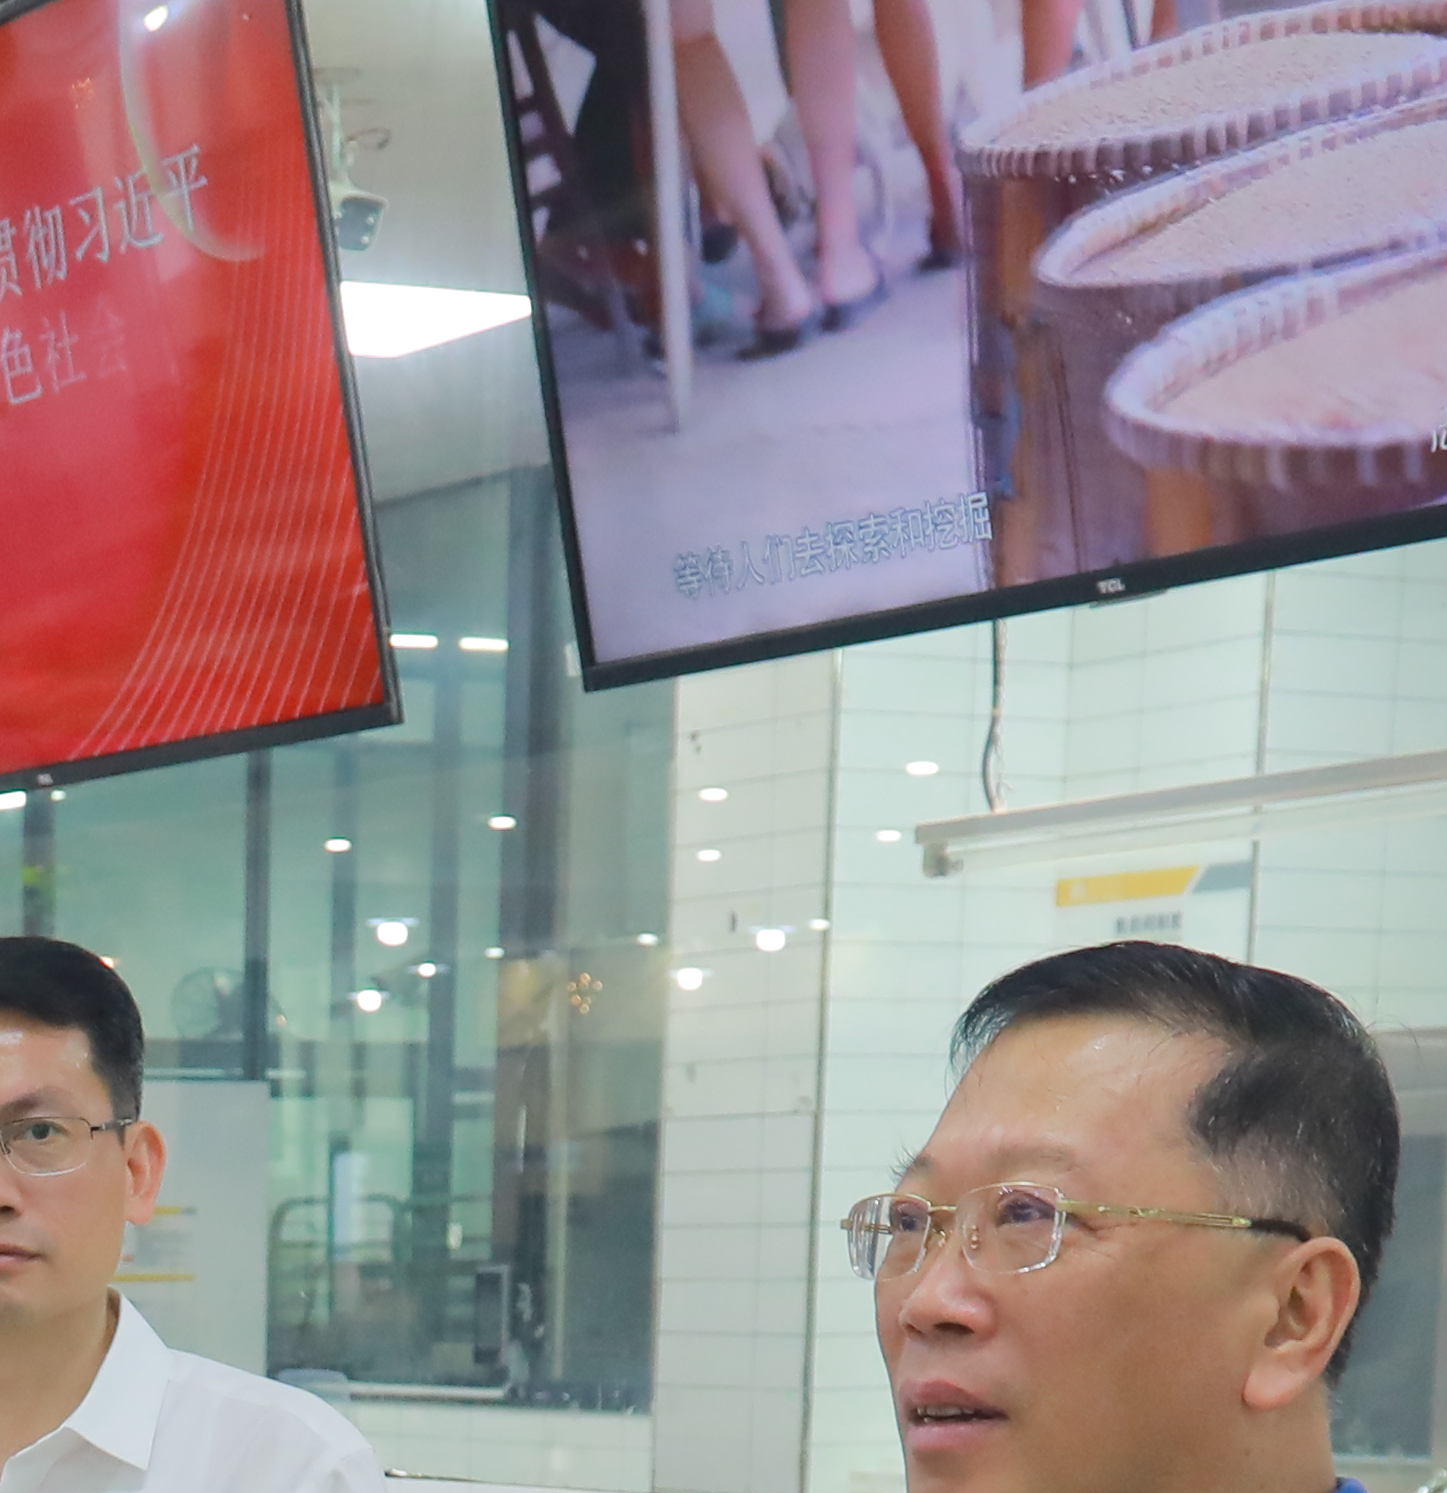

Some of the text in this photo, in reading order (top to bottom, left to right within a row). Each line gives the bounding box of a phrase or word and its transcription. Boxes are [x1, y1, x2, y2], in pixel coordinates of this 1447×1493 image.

[673, 490, 994, 600] 等待人们去探索和挖掘
[1096, 578, 1127, 594] TCL
